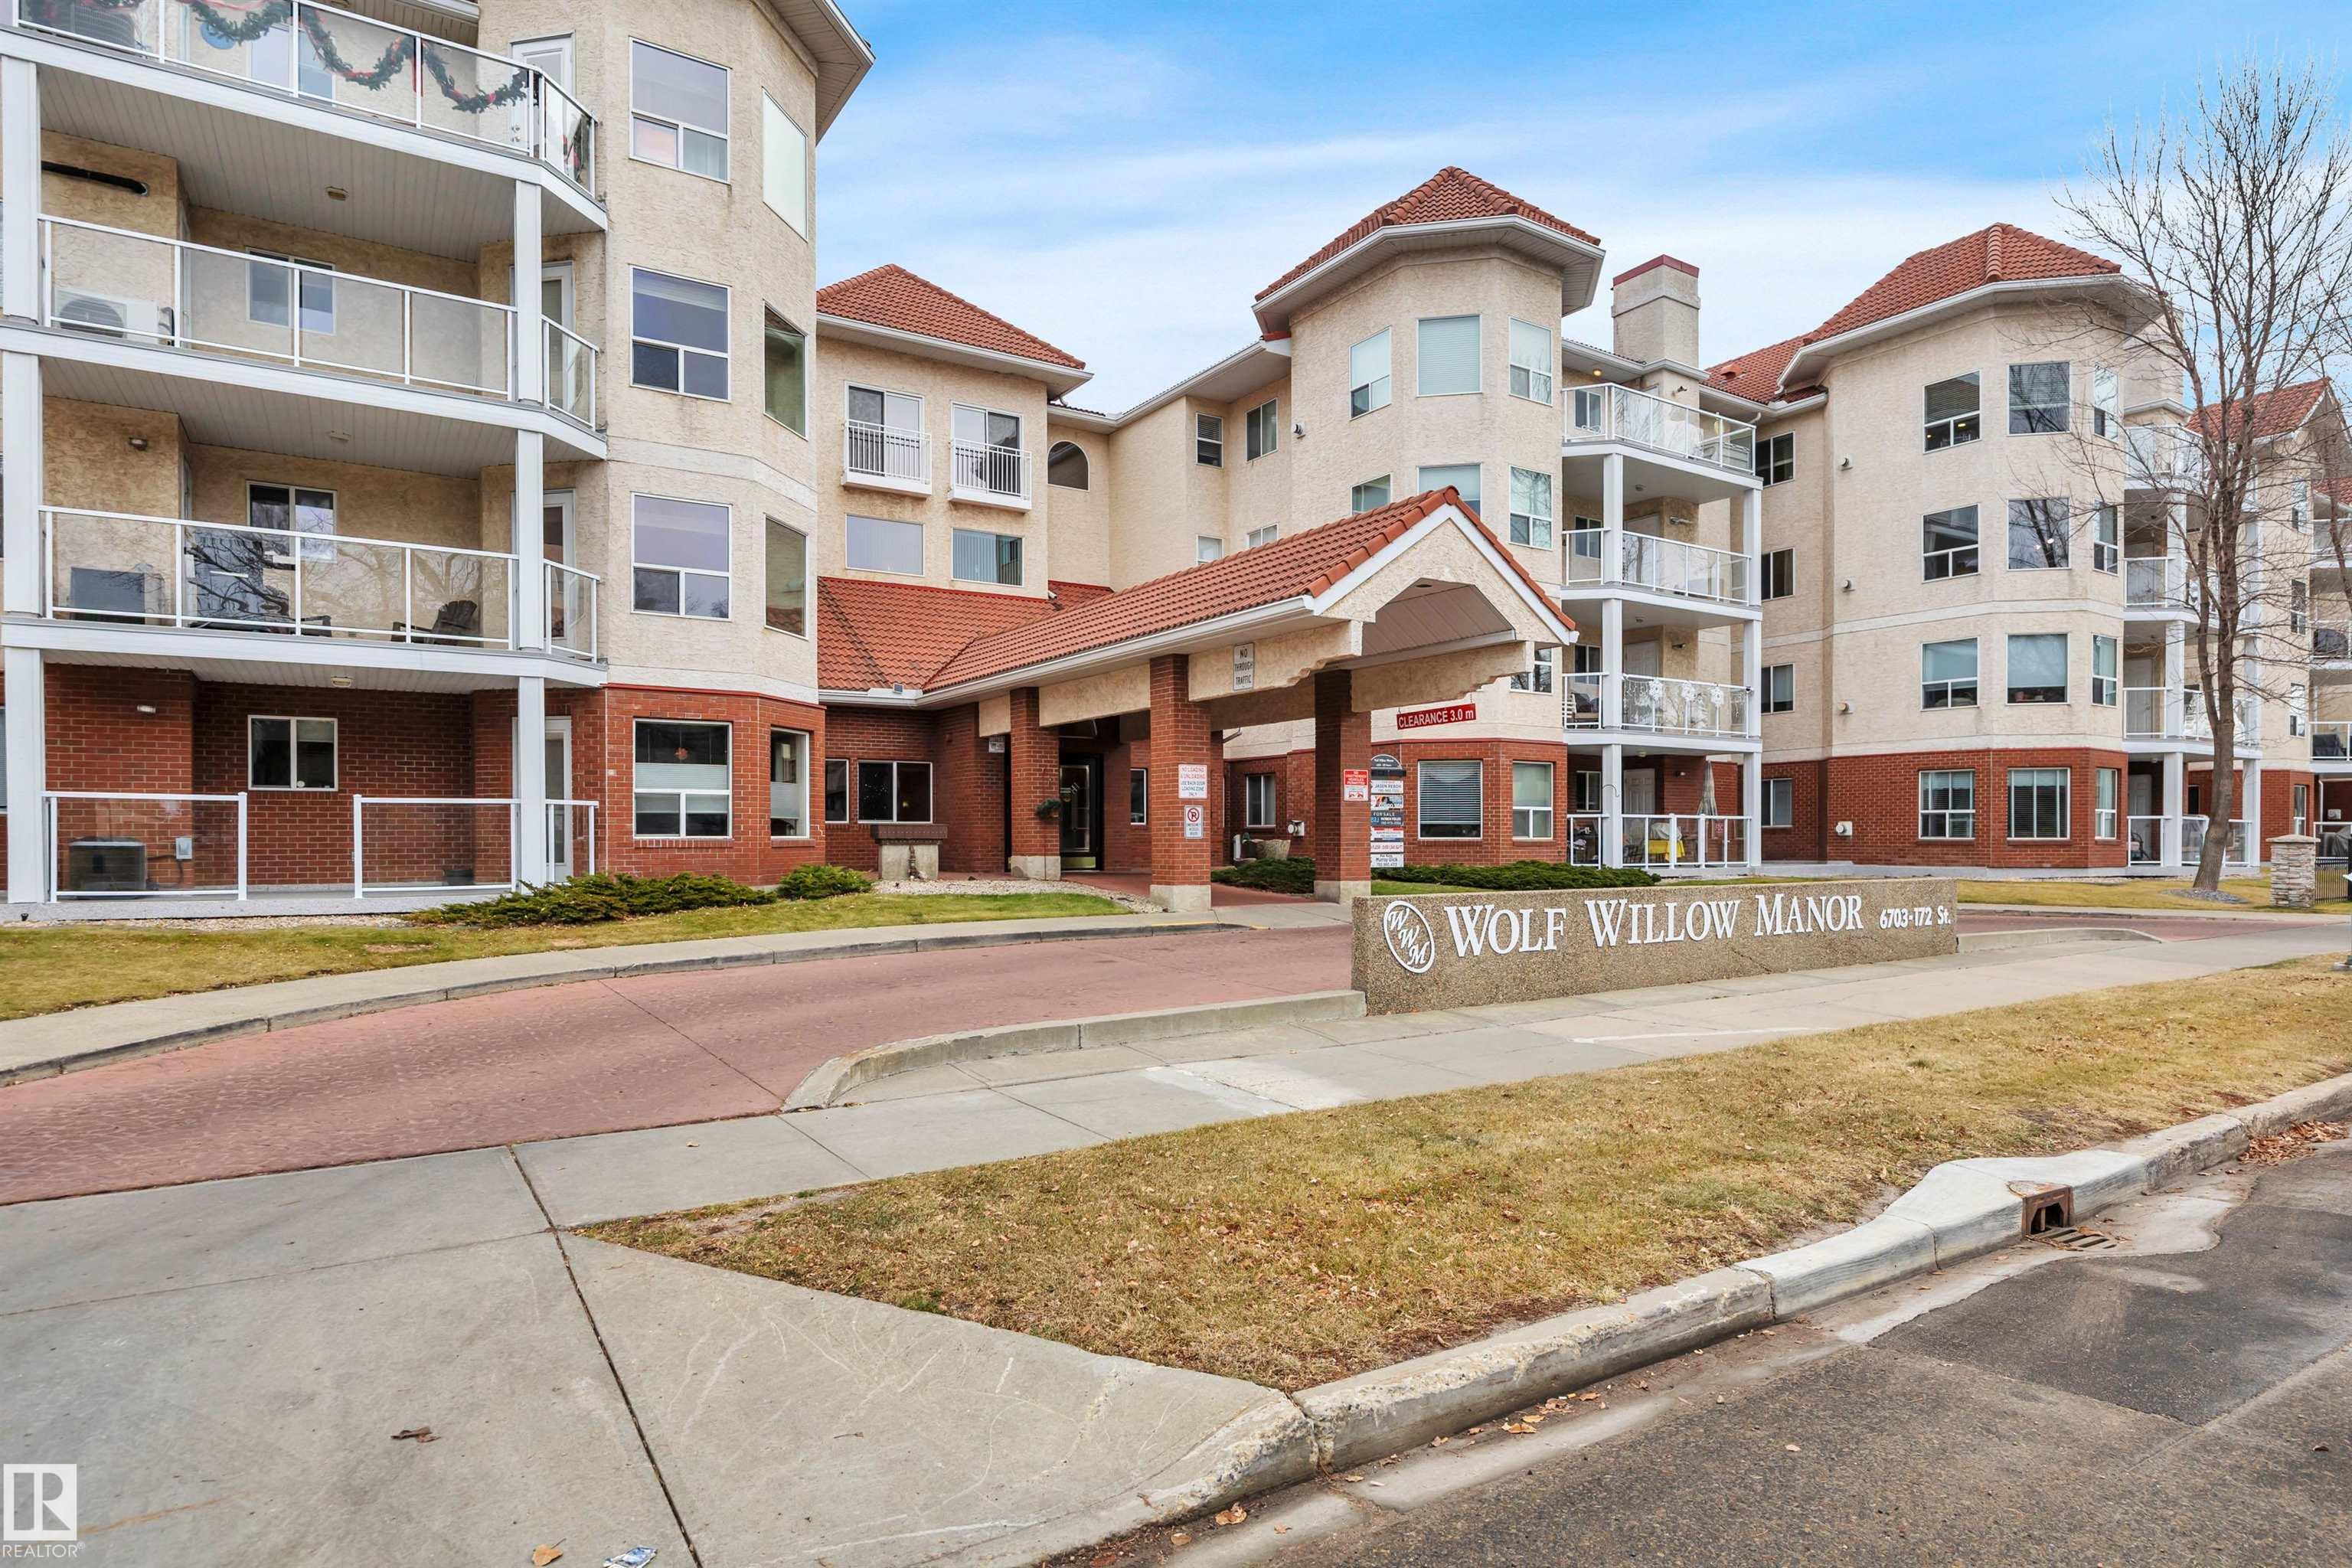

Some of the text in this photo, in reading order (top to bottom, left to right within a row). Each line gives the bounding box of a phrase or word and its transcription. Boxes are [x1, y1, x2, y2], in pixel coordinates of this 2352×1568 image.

[1240, 648, 1248, 658] NO
[1234, 661, 1253, 671] THROUGH
[1236, 675, 1252, 685] TRAFFIC
[1398, 708, 1474, 728] CLEARANCE 3.0 m
[1444, 893, 1952, 957] WOLF WILLOW MANOR 6703-172 St.
